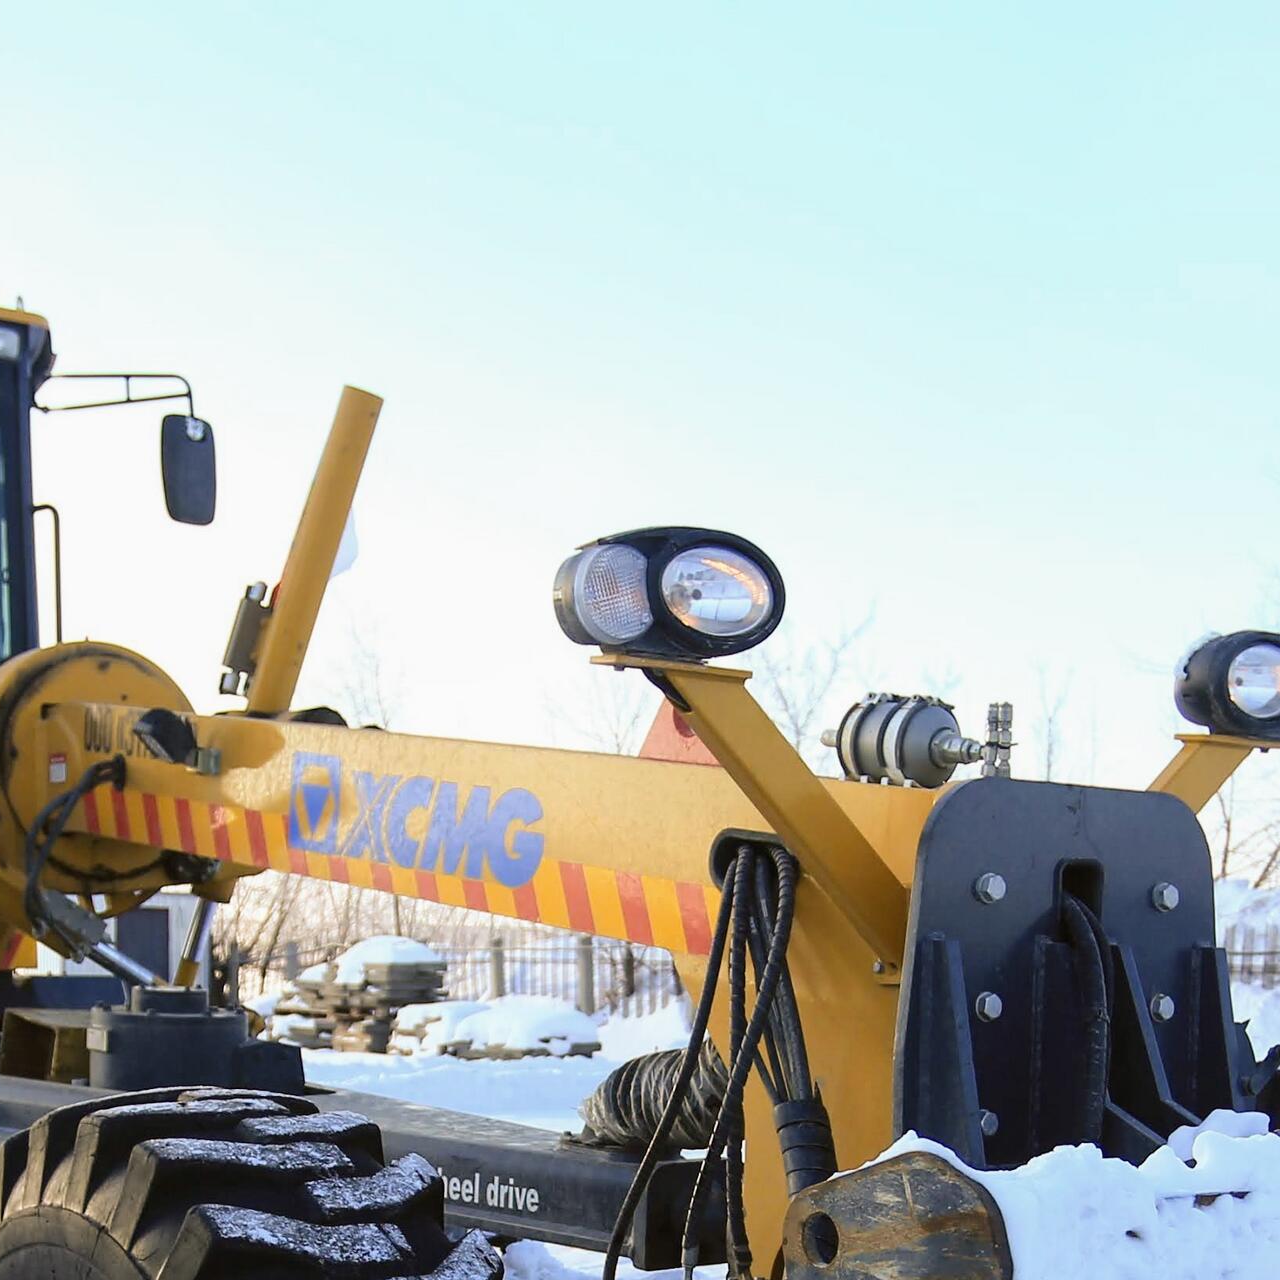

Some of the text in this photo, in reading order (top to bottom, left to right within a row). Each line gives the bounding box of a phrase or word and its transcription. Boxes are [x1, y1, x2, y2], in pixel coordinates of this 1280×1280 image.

[341, 771, 545, 888] XCMG
[437, 1167, 539, 1212] heel drive
